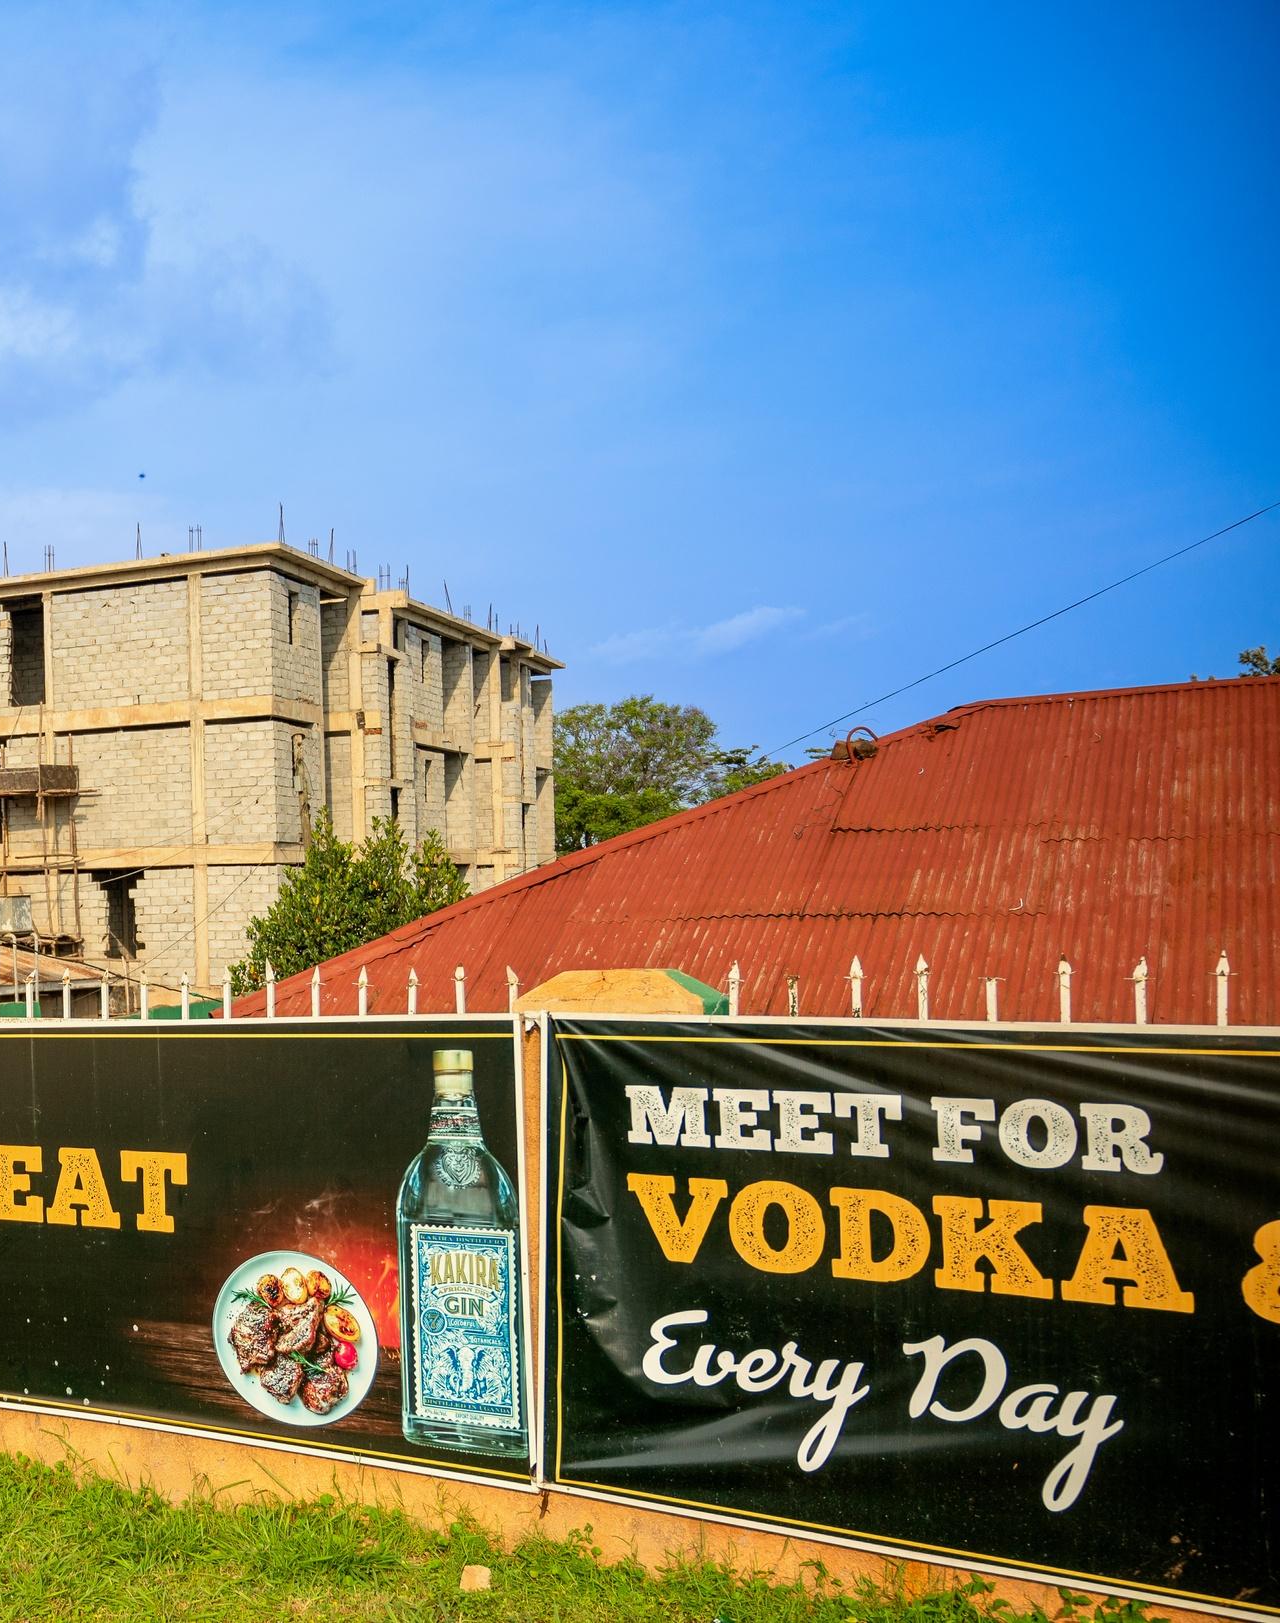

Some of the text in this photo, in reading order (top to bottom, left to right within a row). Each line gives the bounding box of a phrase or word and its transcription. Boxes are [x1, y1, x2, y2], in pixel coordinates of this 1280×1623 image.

[625, 1085, 1165, 1176] MEET FOR
[626, 1172, 1195, 1314] VODKA
[430, 1252, 500, 1292] KAKIRA
[439, 1286, 474, 1295] AFRICAN
[443, 1296, 484, 1317] GIN
[479, 1405, 511, 1414] UGANDA
[642, 1309, 1124, 1513] Every Day
